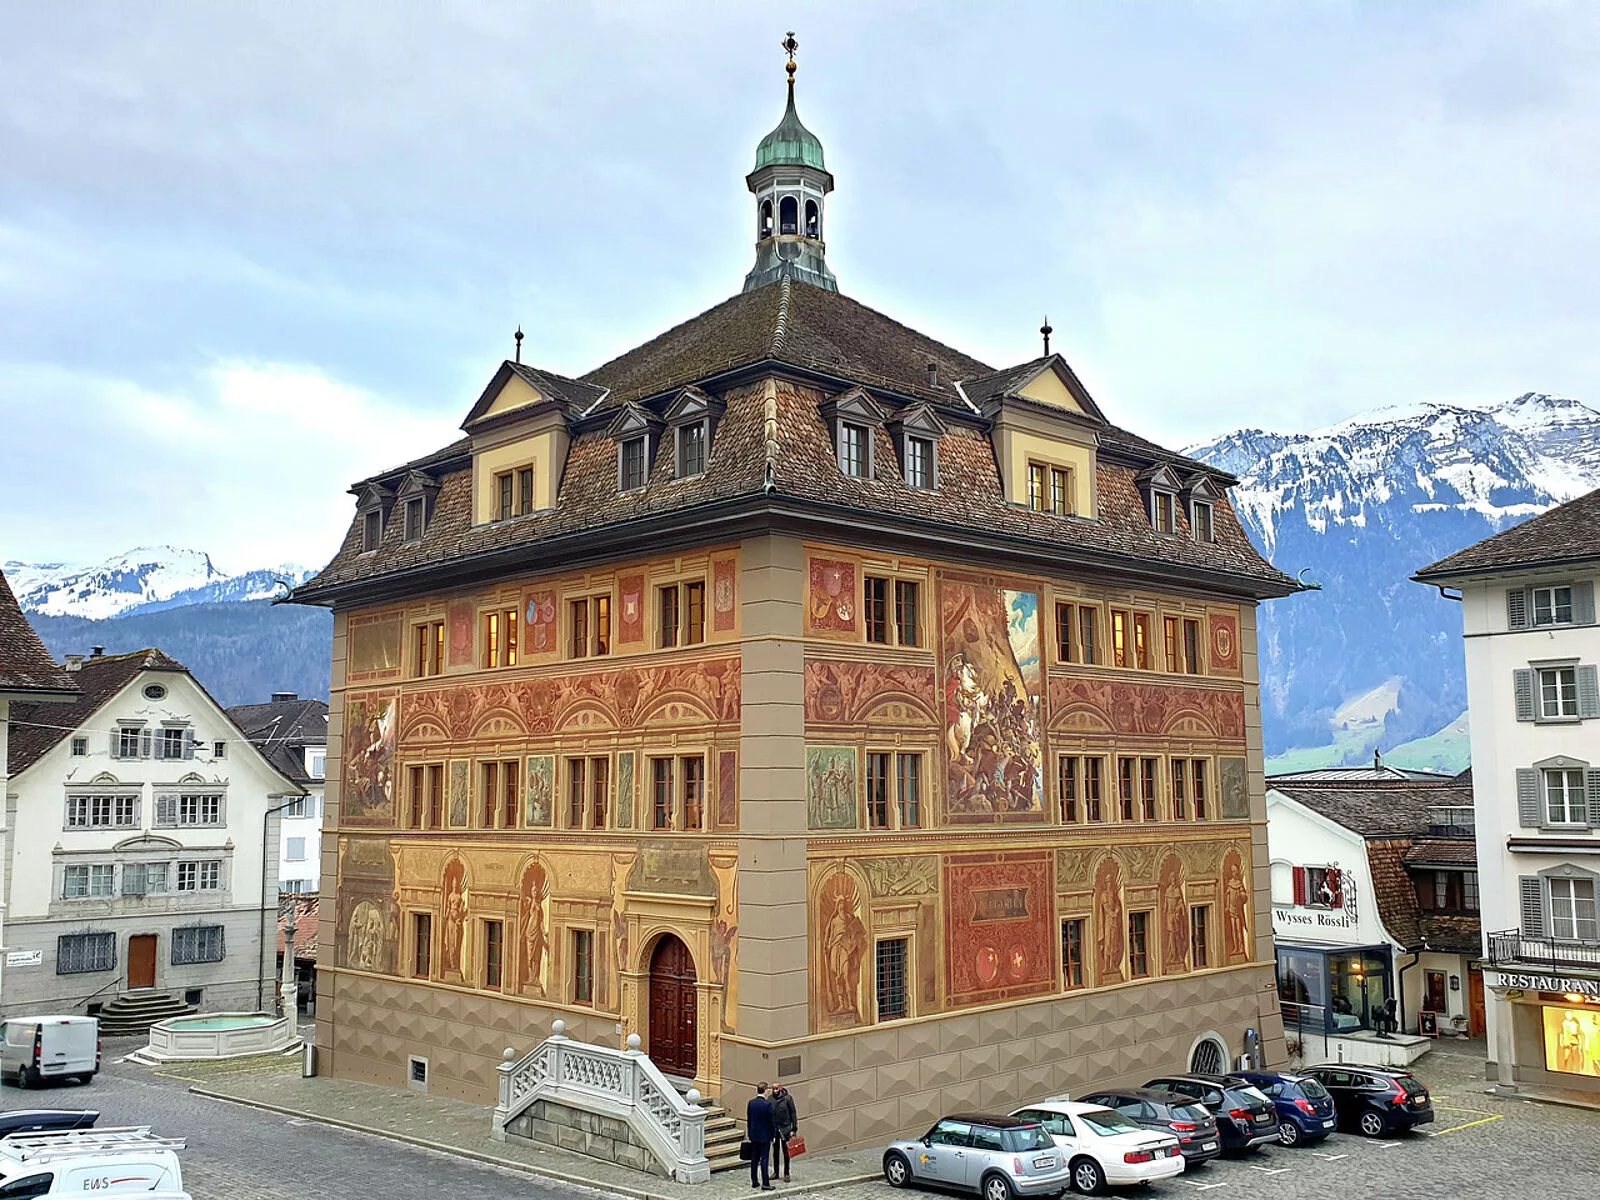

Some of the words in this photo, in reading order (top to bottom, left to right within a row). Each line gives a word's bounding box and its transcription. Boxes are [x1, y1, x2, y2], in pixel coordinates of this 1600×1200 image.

[1276, 910, 1313, 926] Wysses
[1317, 913, 1350, 928] Rössli
[83, 1176, 109, 1191] EWS
